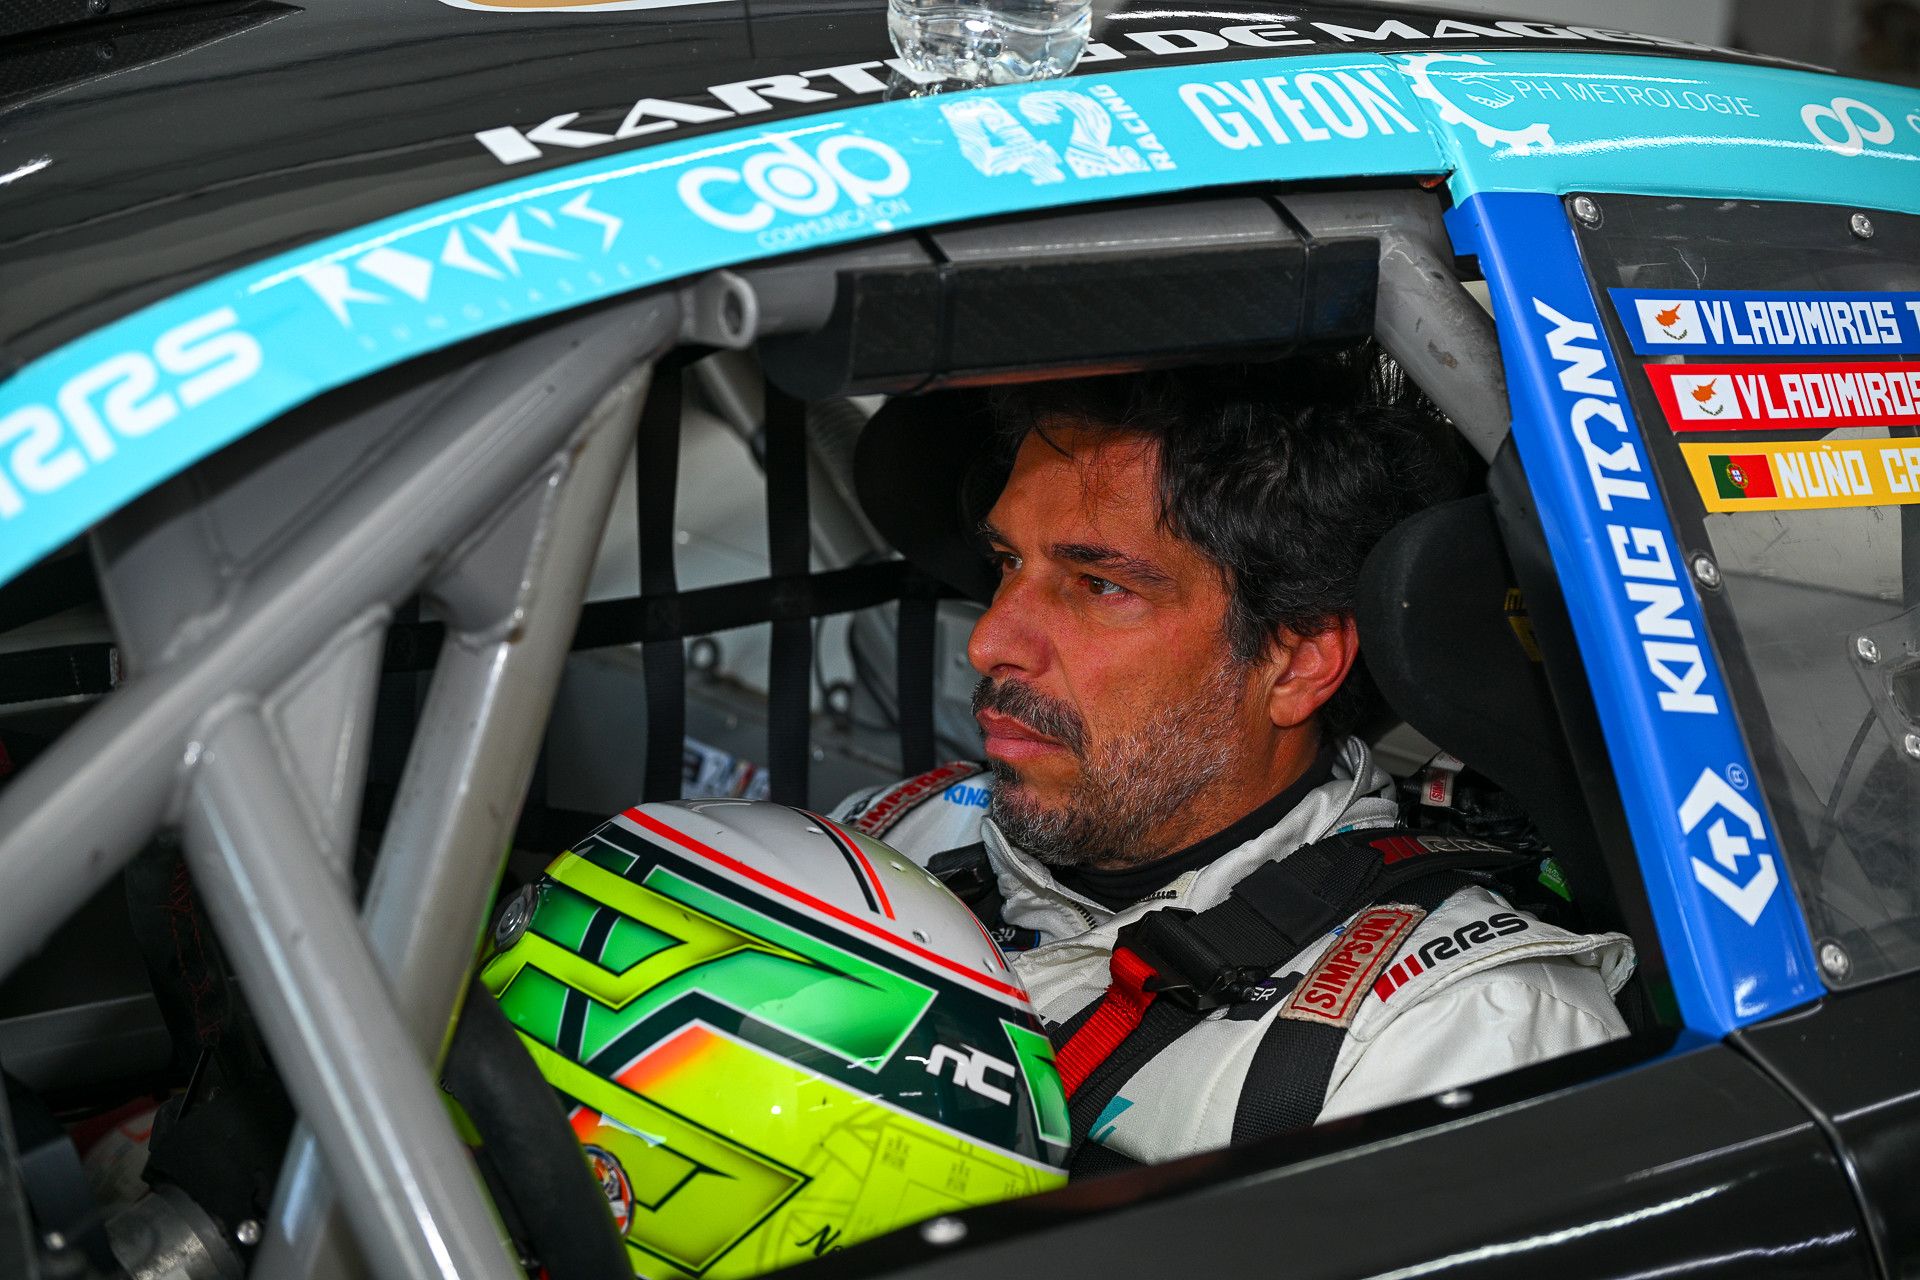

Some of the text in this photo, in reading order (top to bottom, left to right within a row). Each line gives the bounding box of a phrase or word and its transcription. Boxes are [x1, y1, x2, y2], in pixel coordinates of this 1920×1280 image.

[1124, 24, 1316, 56] DE
[1087, 83, 1178, 171] RACING
[1178, 69, 1420, 151] GYEON
[1514, 79, 1761, 118] PH METROLOGIE
[940, 87, 1153, 186] 42
[1699, 300, 1903, 345] VLADIMIROS
[1606, 524, 1719, 714] KING
[943, 783, 992, 809] KING
[1304, 916, 1396, 1010] SIMPSON
[1418, 912, 1529, 970] RRS
